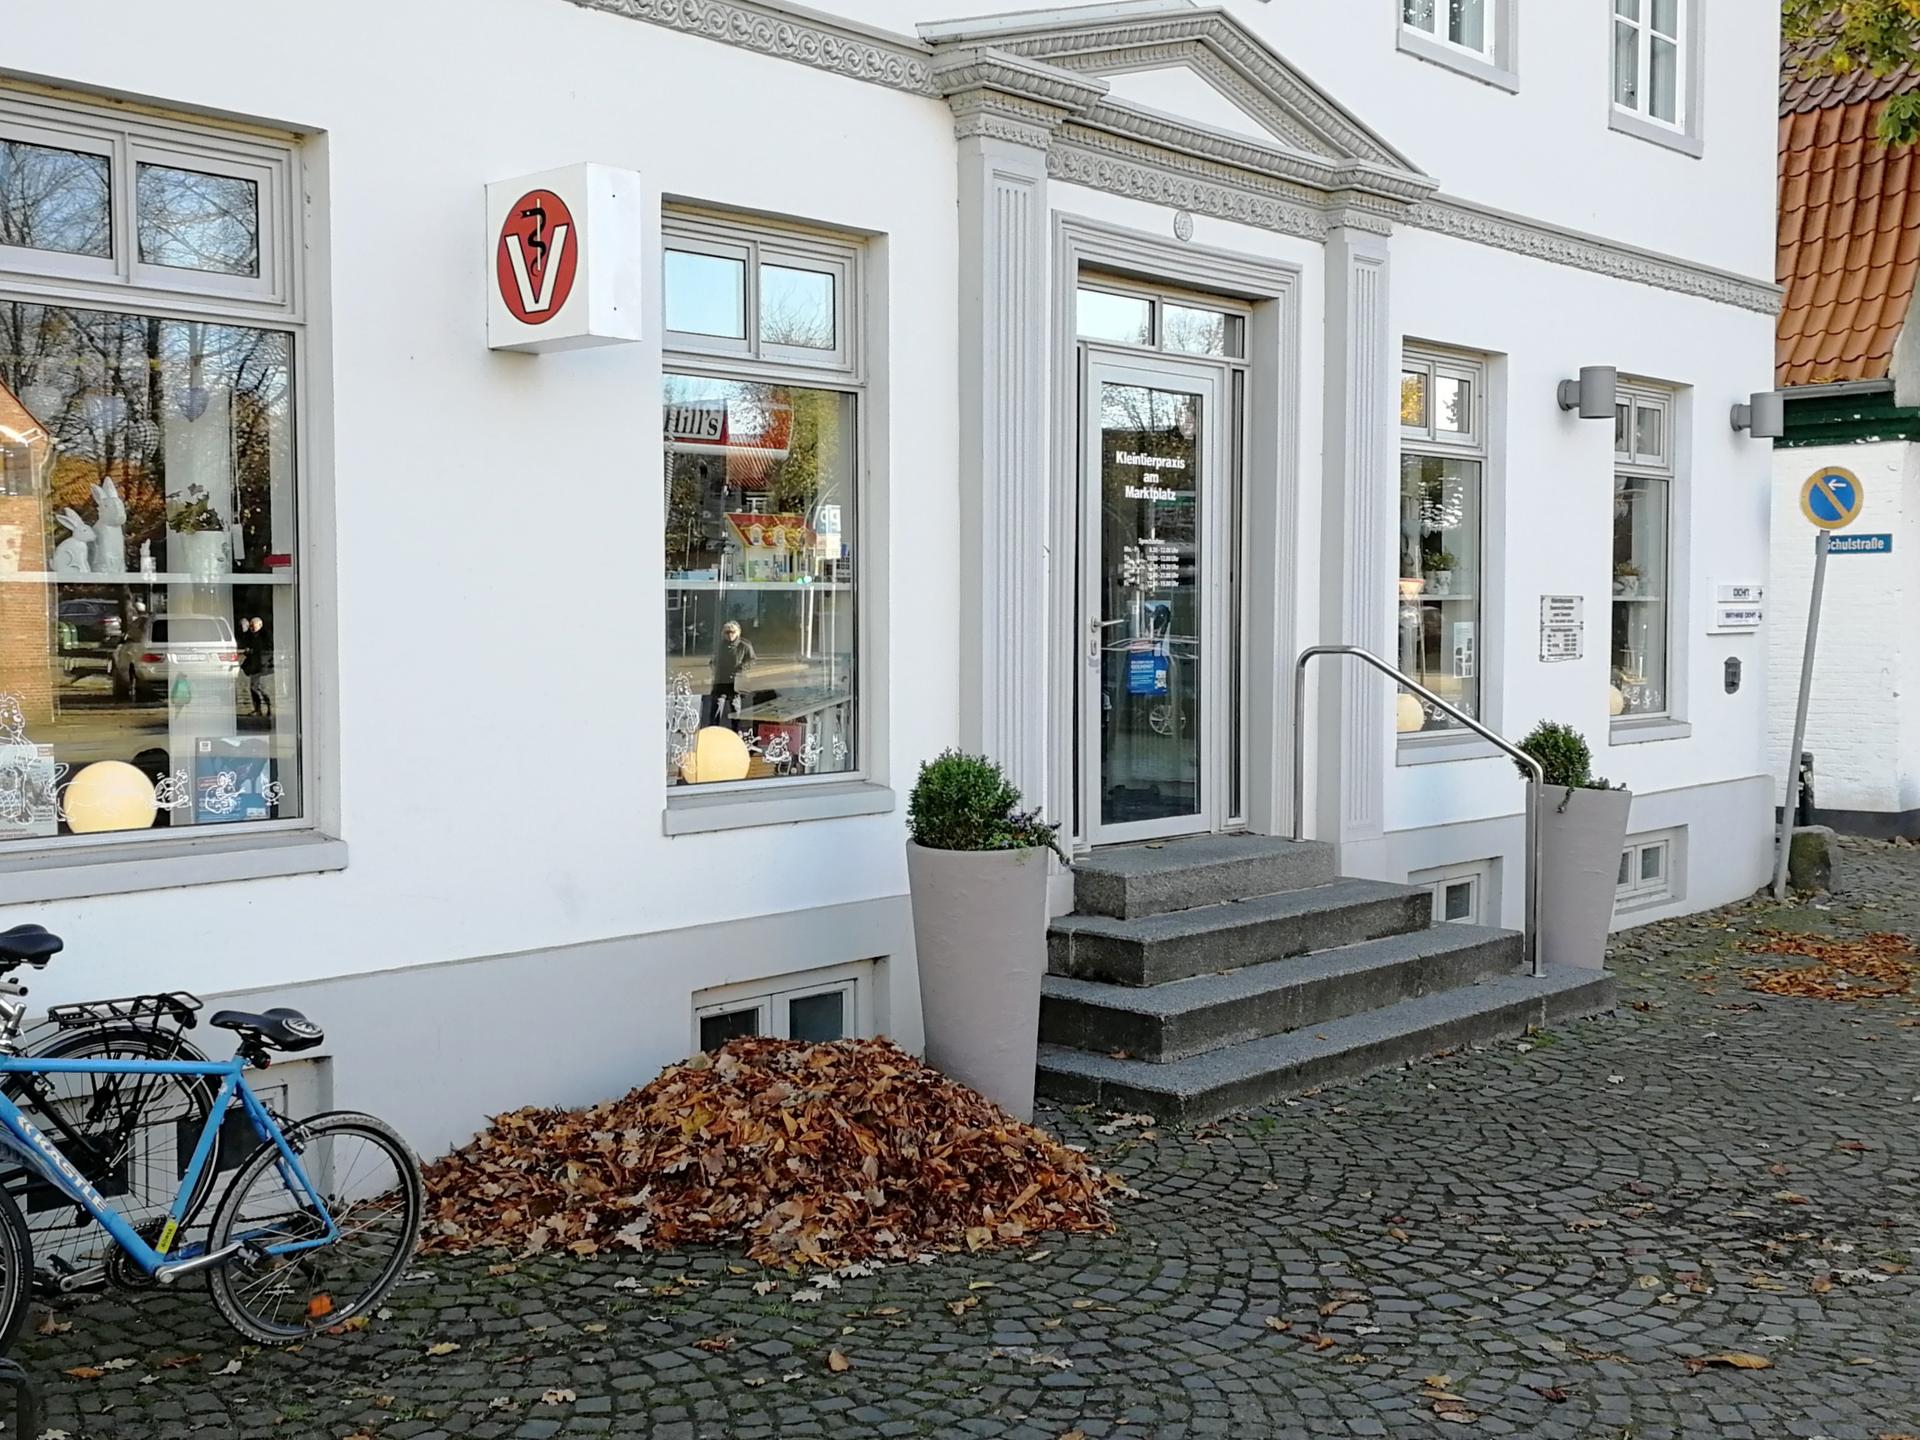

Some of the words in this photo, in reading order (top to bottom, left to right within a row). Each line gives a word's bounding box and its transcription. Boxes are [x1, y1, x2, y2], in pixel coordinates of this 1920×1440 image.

[1115, 450, 1186, 470] Kleintierpraxis
[1143, 472, 1159, 483] am
[1124, 485, 1177, 503] Marktplatz
